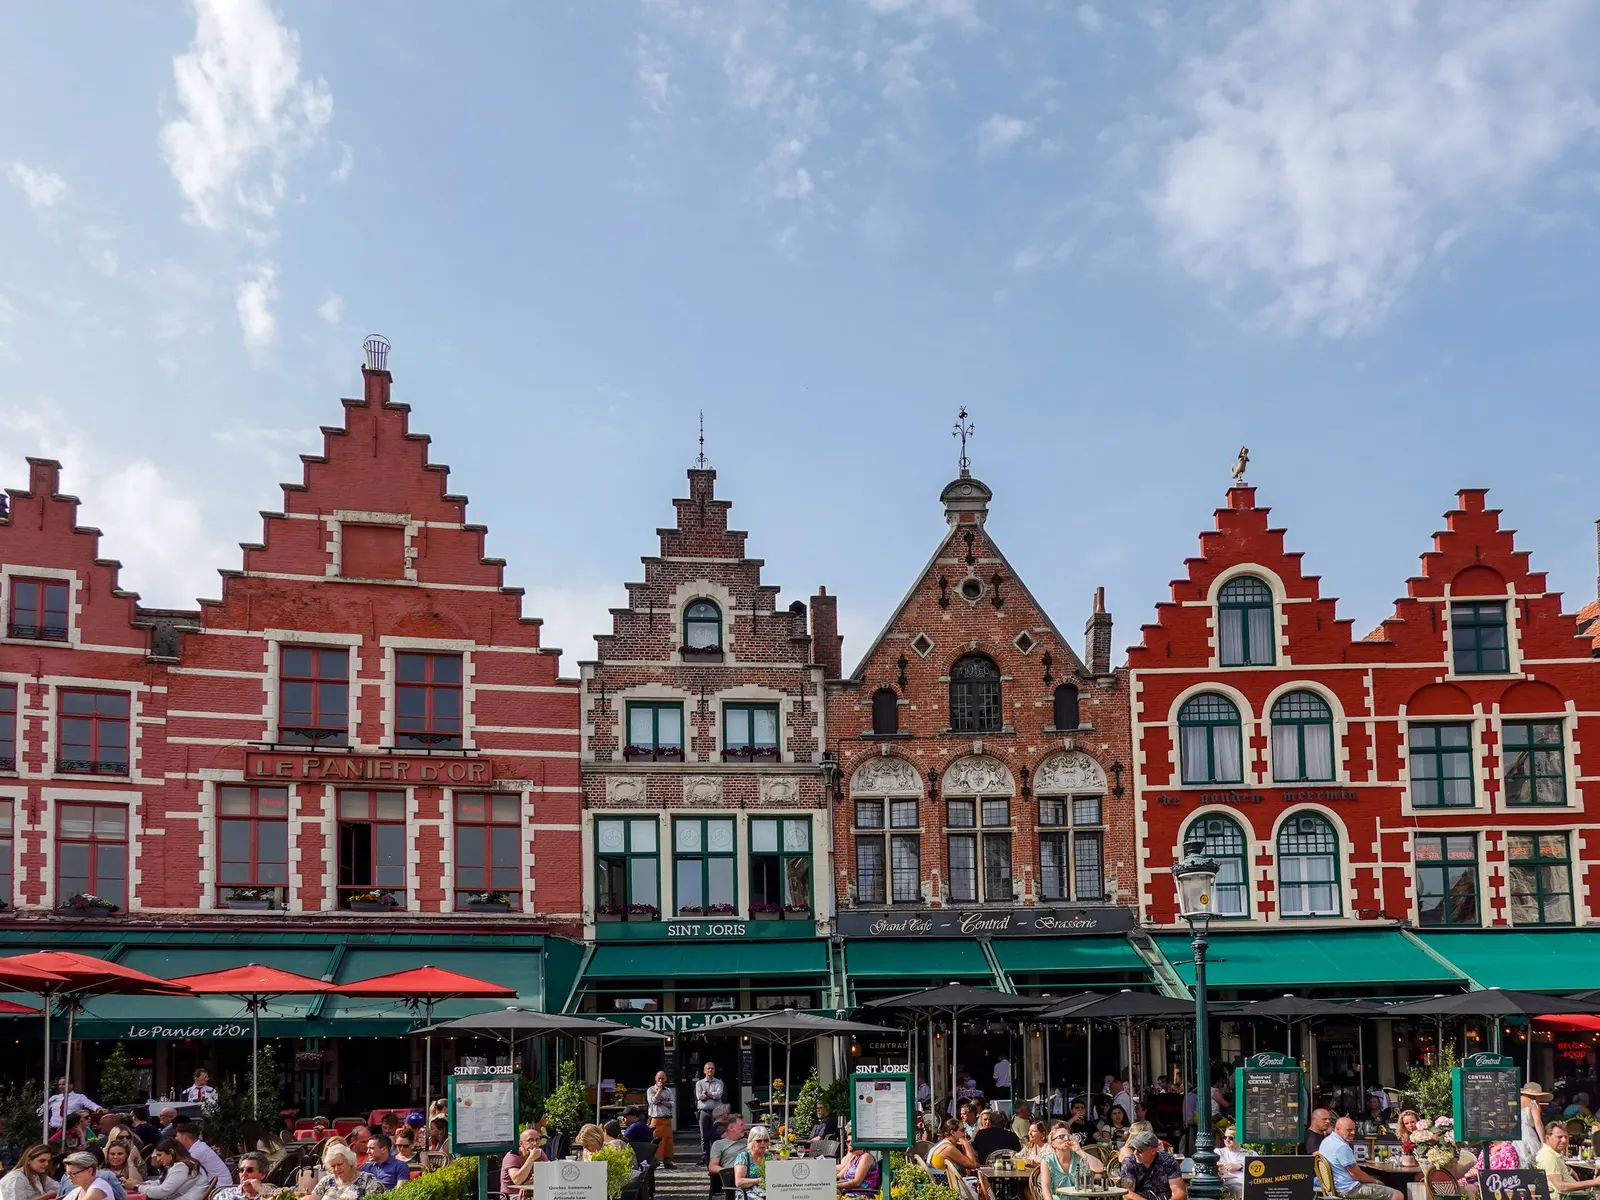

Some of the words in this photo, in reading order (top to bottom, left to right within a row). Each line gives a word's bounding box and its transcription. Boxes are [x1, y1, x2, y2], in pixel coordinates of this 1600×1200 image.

[256, 759, 294, 777] LE
[302, 757, 411, 780] PANIER
[668, 925, 700, 936] SINT
[705, 924, 746, 936] JORIS
[869, 919, 908, 935] Grand
[959, 912, 1011, 934] Central
[1034, 916, 1097, 929] Brasserie
[640, 1013, 760, 1031] SINT-JO
[129, 1025, 150, 1037] Le
[151, 1025, 209, 1037] Panier
[212, 1024, 250, 1037] d'Or
[1258, 1054, 1284, 1067] Central
[1475, 1054, 1501, 1067] Central
[454, 1066, 479, 1075] SINT
[483, 1065, 513, 1074] JORIS
[856, 1065, 878, 1073] SINT
[881, 1064, 909, 1073] JORIS
[1253, 1177, 1273, 1185] CENTRAL
[1486, 1173, 1521, 1192] Beer
